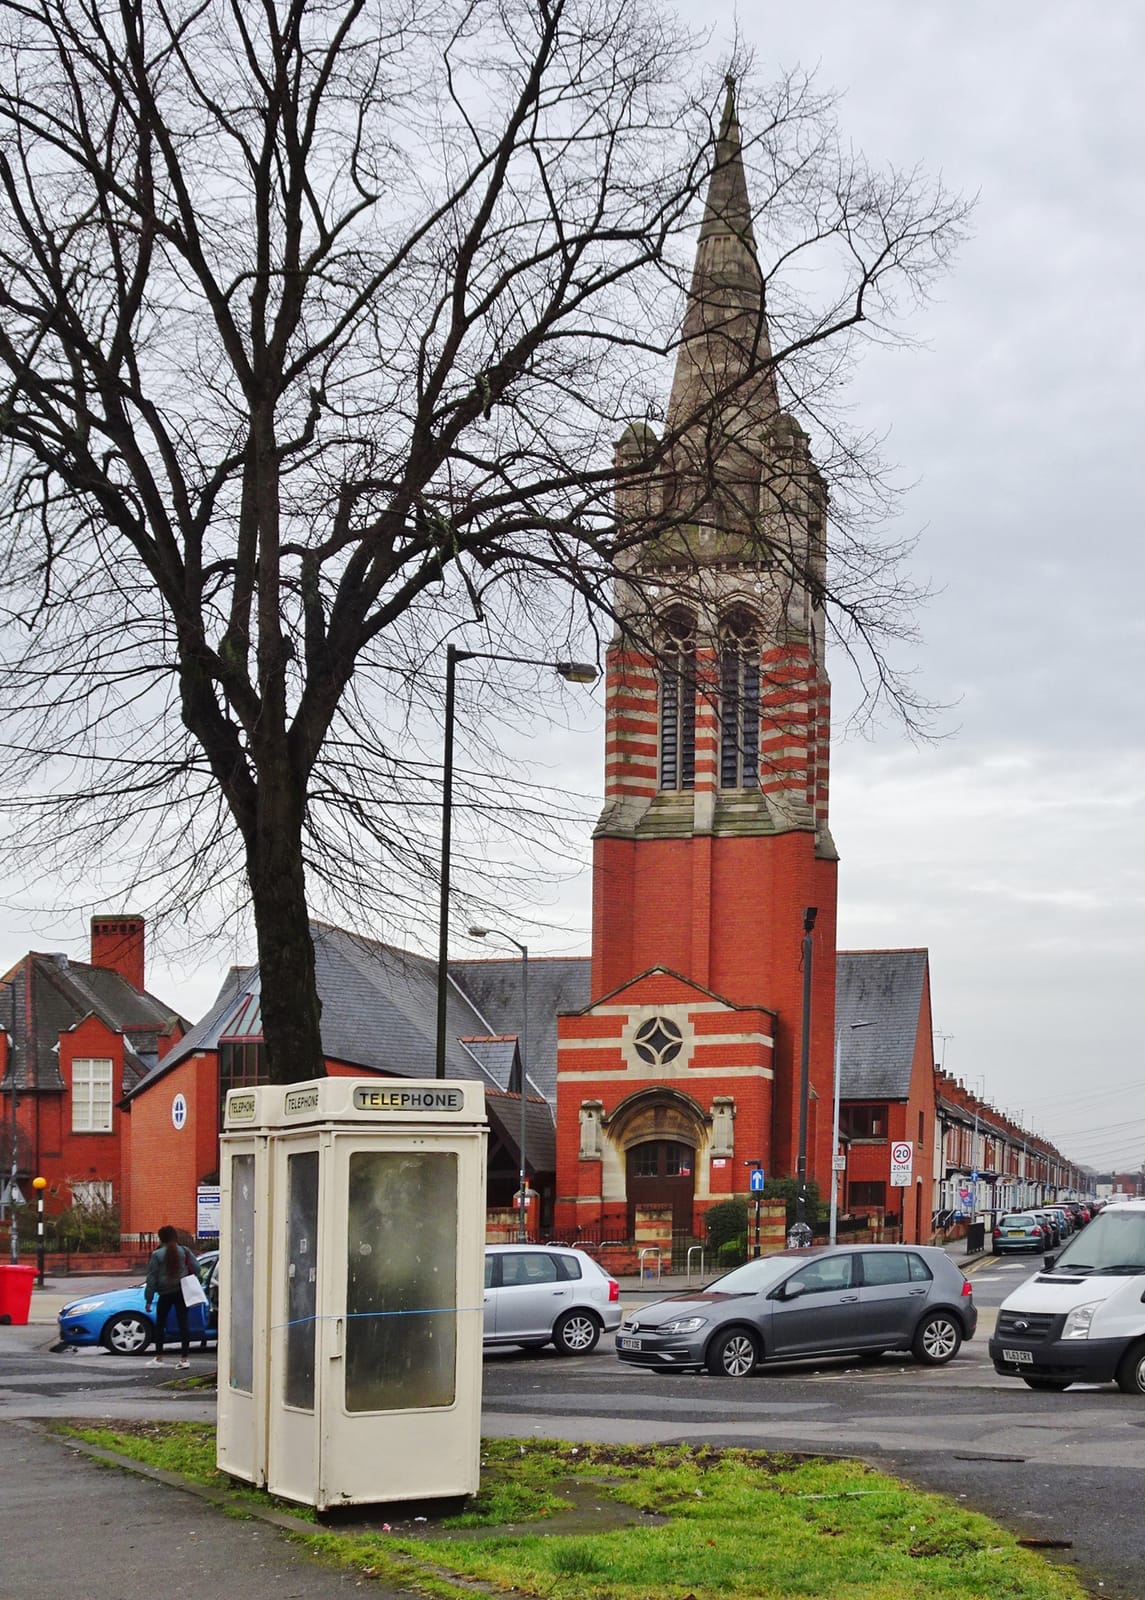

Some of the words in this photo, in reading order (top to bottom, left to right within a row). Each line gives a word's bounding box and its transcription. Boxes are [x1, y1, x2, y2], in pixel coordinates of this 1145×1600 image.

[289, 1094, 319, 1110] TELEPHONE
[359, 1093, 457, 1106] TELEPHONE
[232, 1101, 255, 1113] TELEPHONE
[896, 1149, 908, 1158] 20
